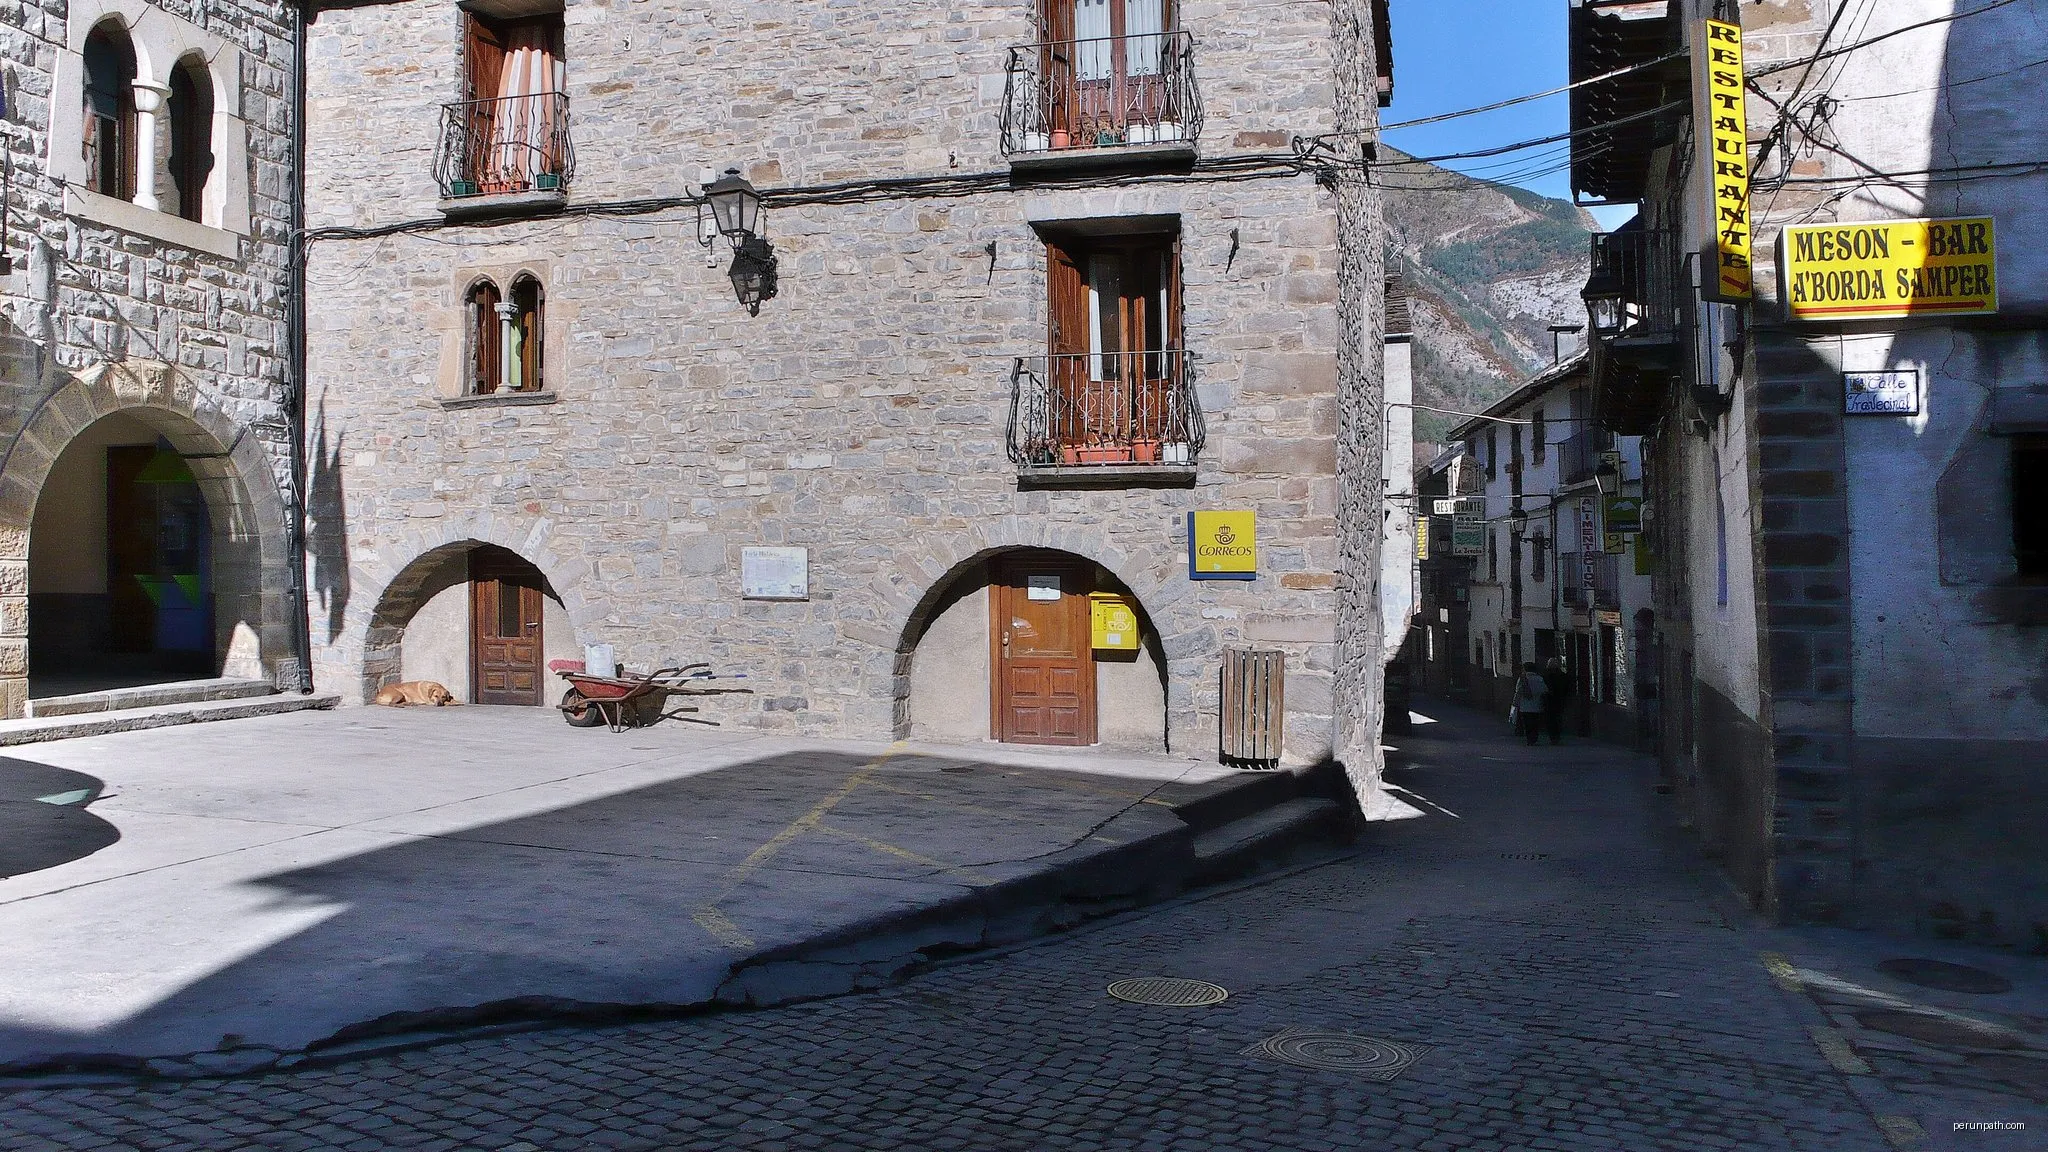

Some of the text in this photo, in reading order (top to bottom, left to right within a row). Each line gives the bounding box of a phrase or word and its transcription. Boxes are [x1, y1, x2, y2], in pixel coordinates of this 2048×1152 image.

[1709, 24, 1749, 271] RESTAURANTE
[1794, 227, 1890, 264] MESON
[1928, 223, 1988, 258] BAR
[1793, 263, 1991, 303] A'BORDA SAMPER
[1868, 374, 1907, 390] Calle
[1436, 501, 1481, 512] RESTAURANTE
[1198, 544, 1252, 558] CORREOS
